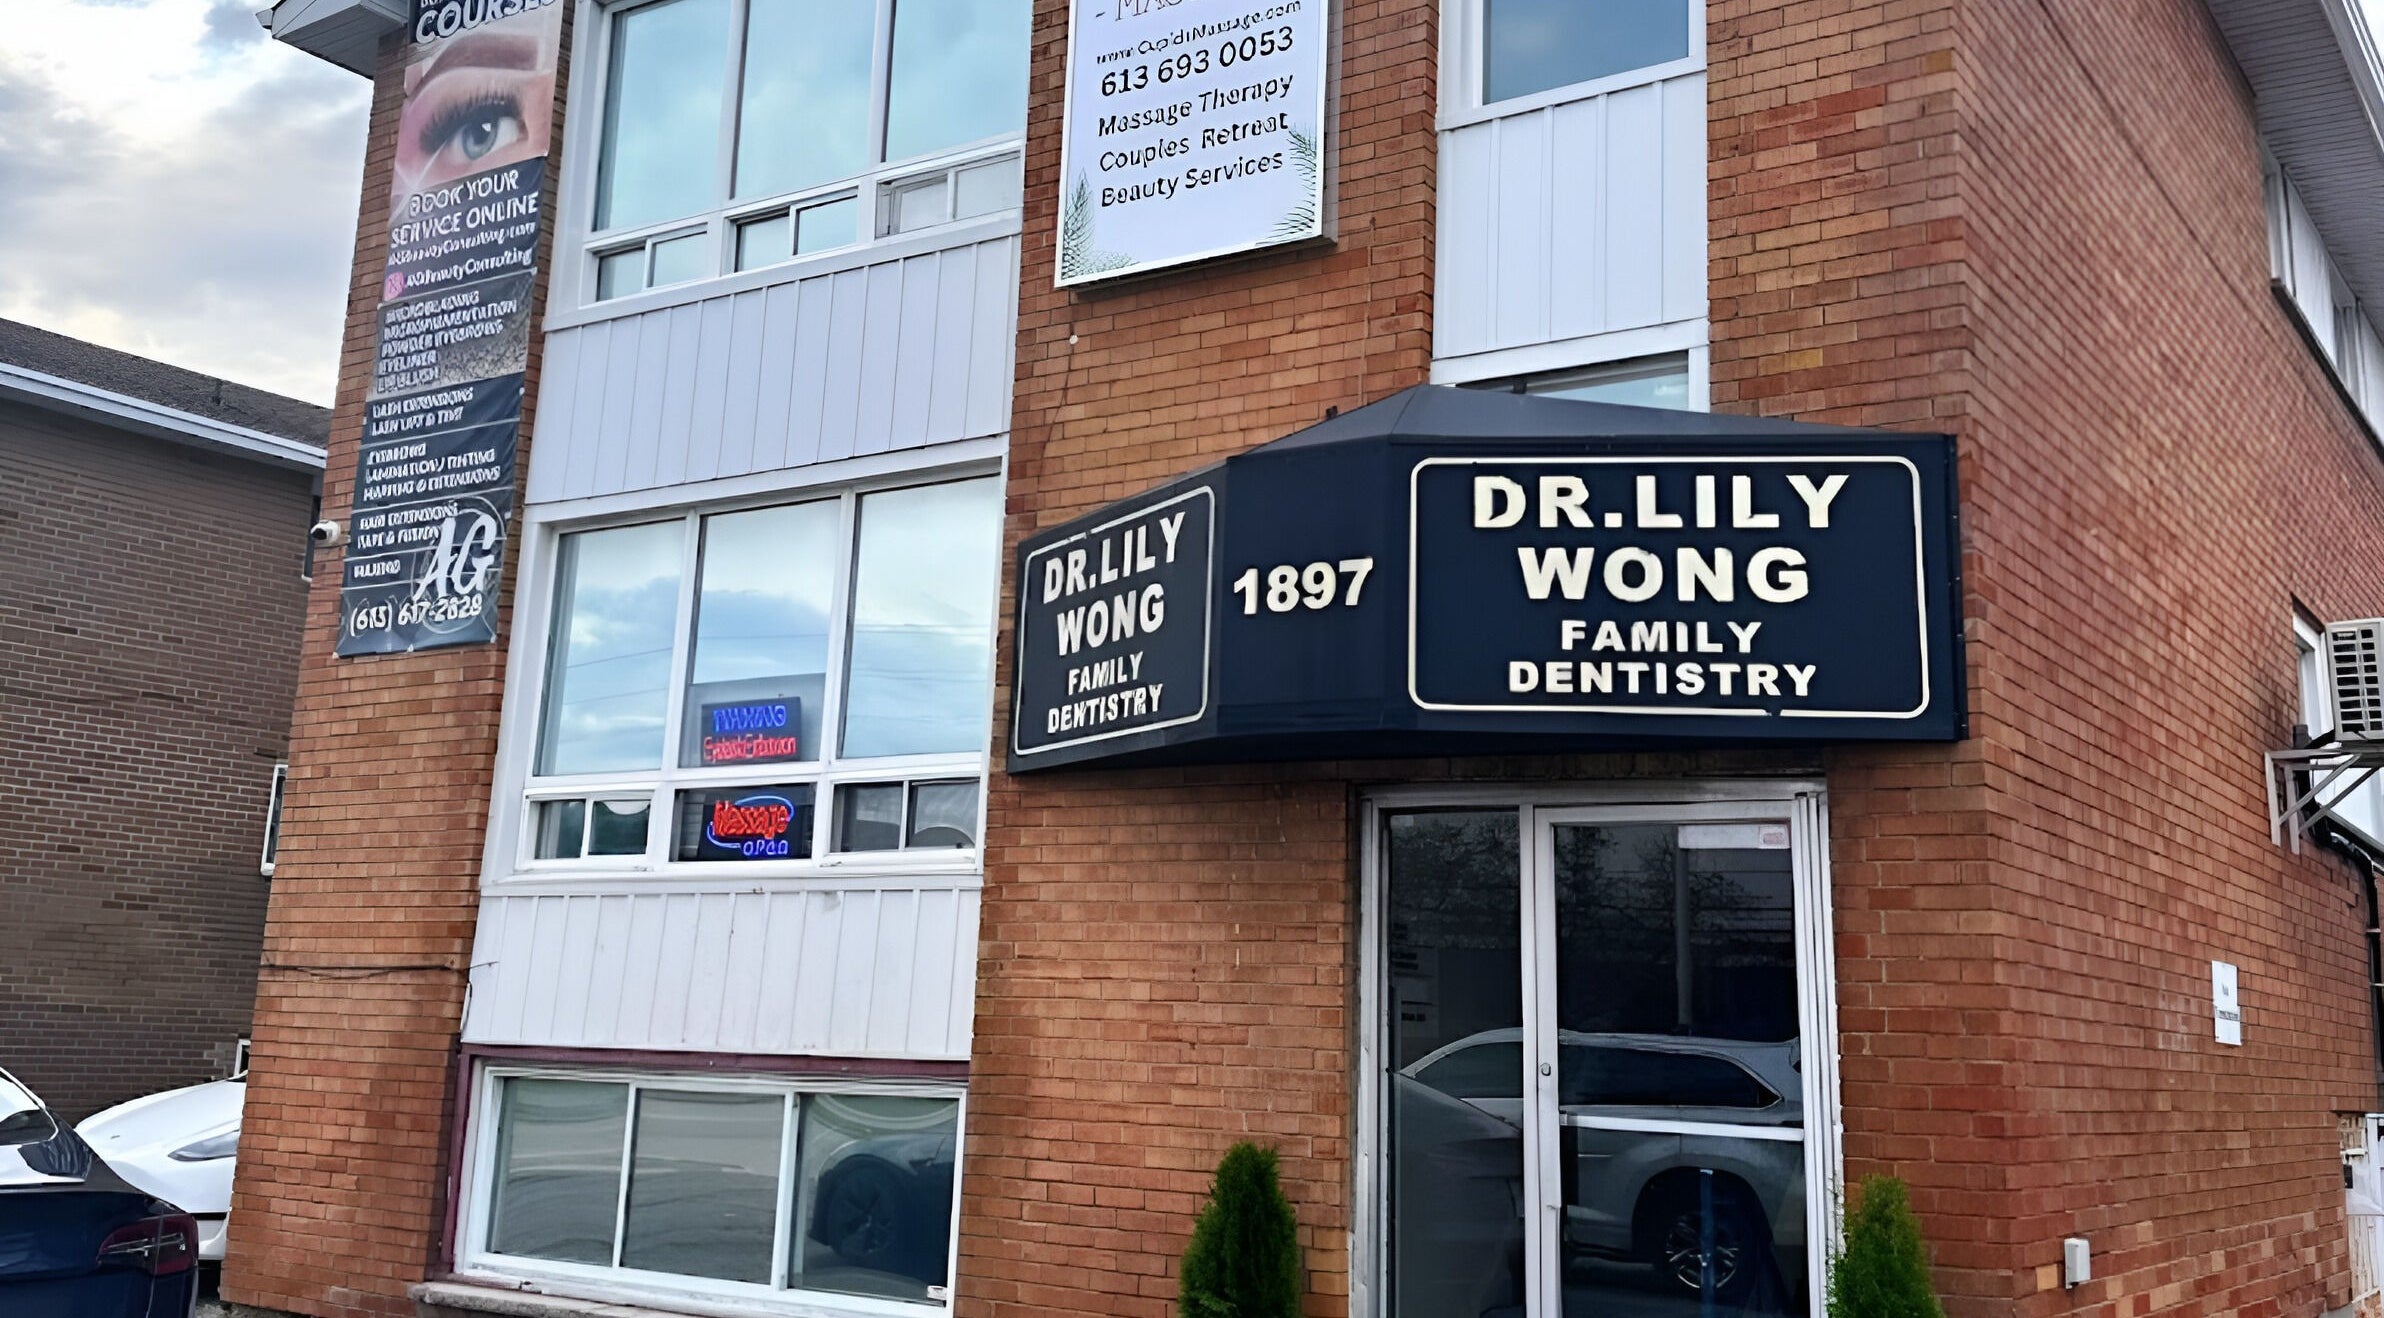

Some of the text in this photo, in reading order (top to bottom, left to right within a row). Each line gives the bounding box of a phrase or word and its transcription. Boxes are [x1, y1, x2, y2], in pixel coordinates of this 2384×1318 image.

[1101, 26, 1294, 97] 613 693 0053
[1098, 75, 1294, 137] Massage Therapy
[1099, 112, 1289, 172] Couples Retreat
[466, 169, 519, 200] YOUR
[1101, 152, 1284, 208] Beauty Services
[390, 191, 539, 249] SERVICE ONLINE
[1233, 557, 1374, 615] 1897
[1517, 547, 1809, 603] WONG
[1057, 583, 1164, 656] WONG
[1561, 620, 1762, 653] FAMILY
[1068, 651, 1143, 695] FAMILY
[1508, 662, 1817, 697] DENTISTRY
[1047, 683, 1164, 734] DENTISTRY
